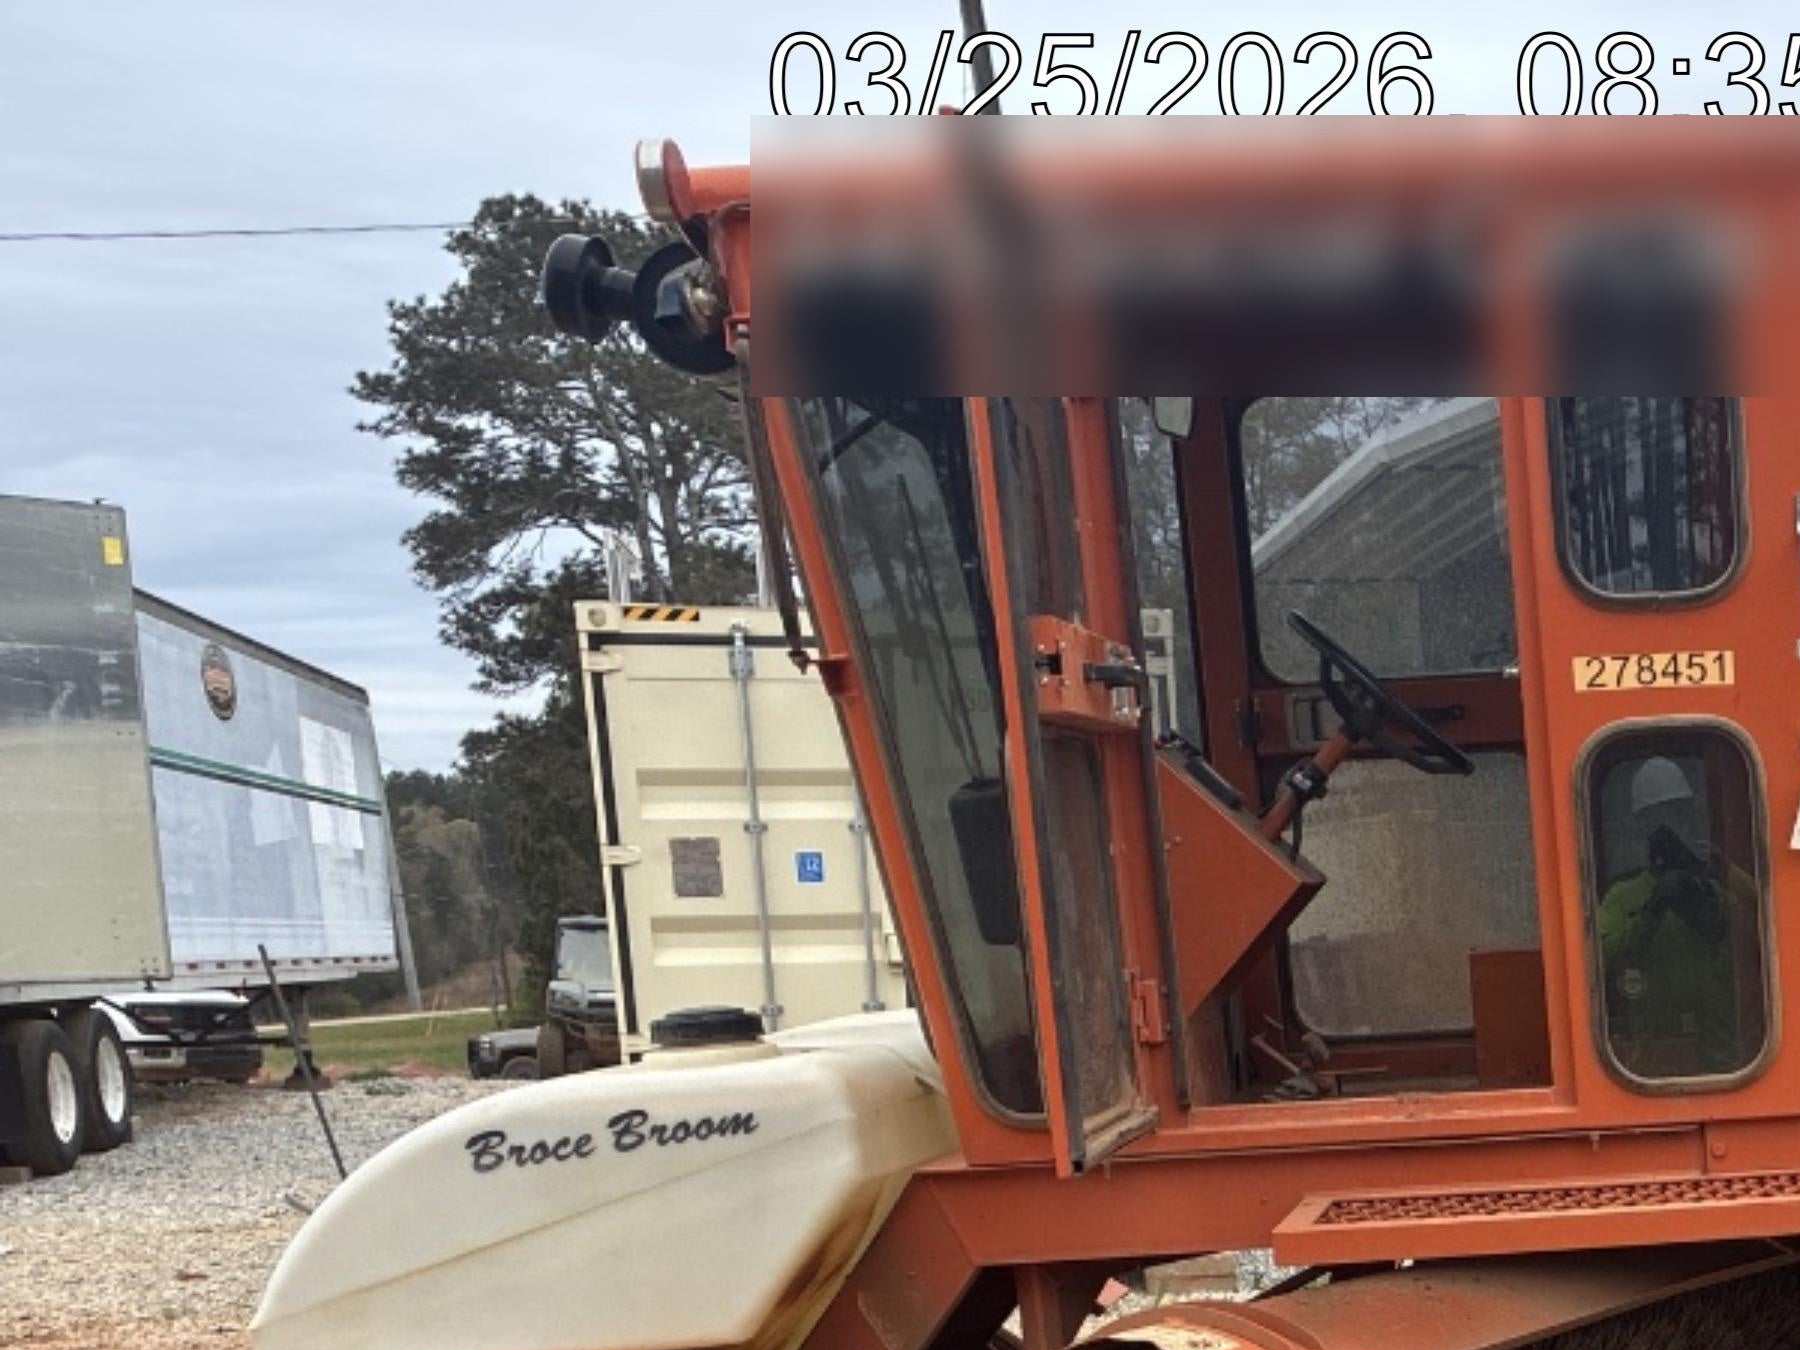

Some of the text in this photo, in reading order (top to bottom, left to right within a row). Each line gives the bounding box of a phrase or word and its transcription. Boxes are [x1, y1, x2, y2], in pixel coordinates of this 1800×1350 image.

[1586, 653, 1725, 688] 278451
[464, 1108, 759, 1173] Broce Broom
